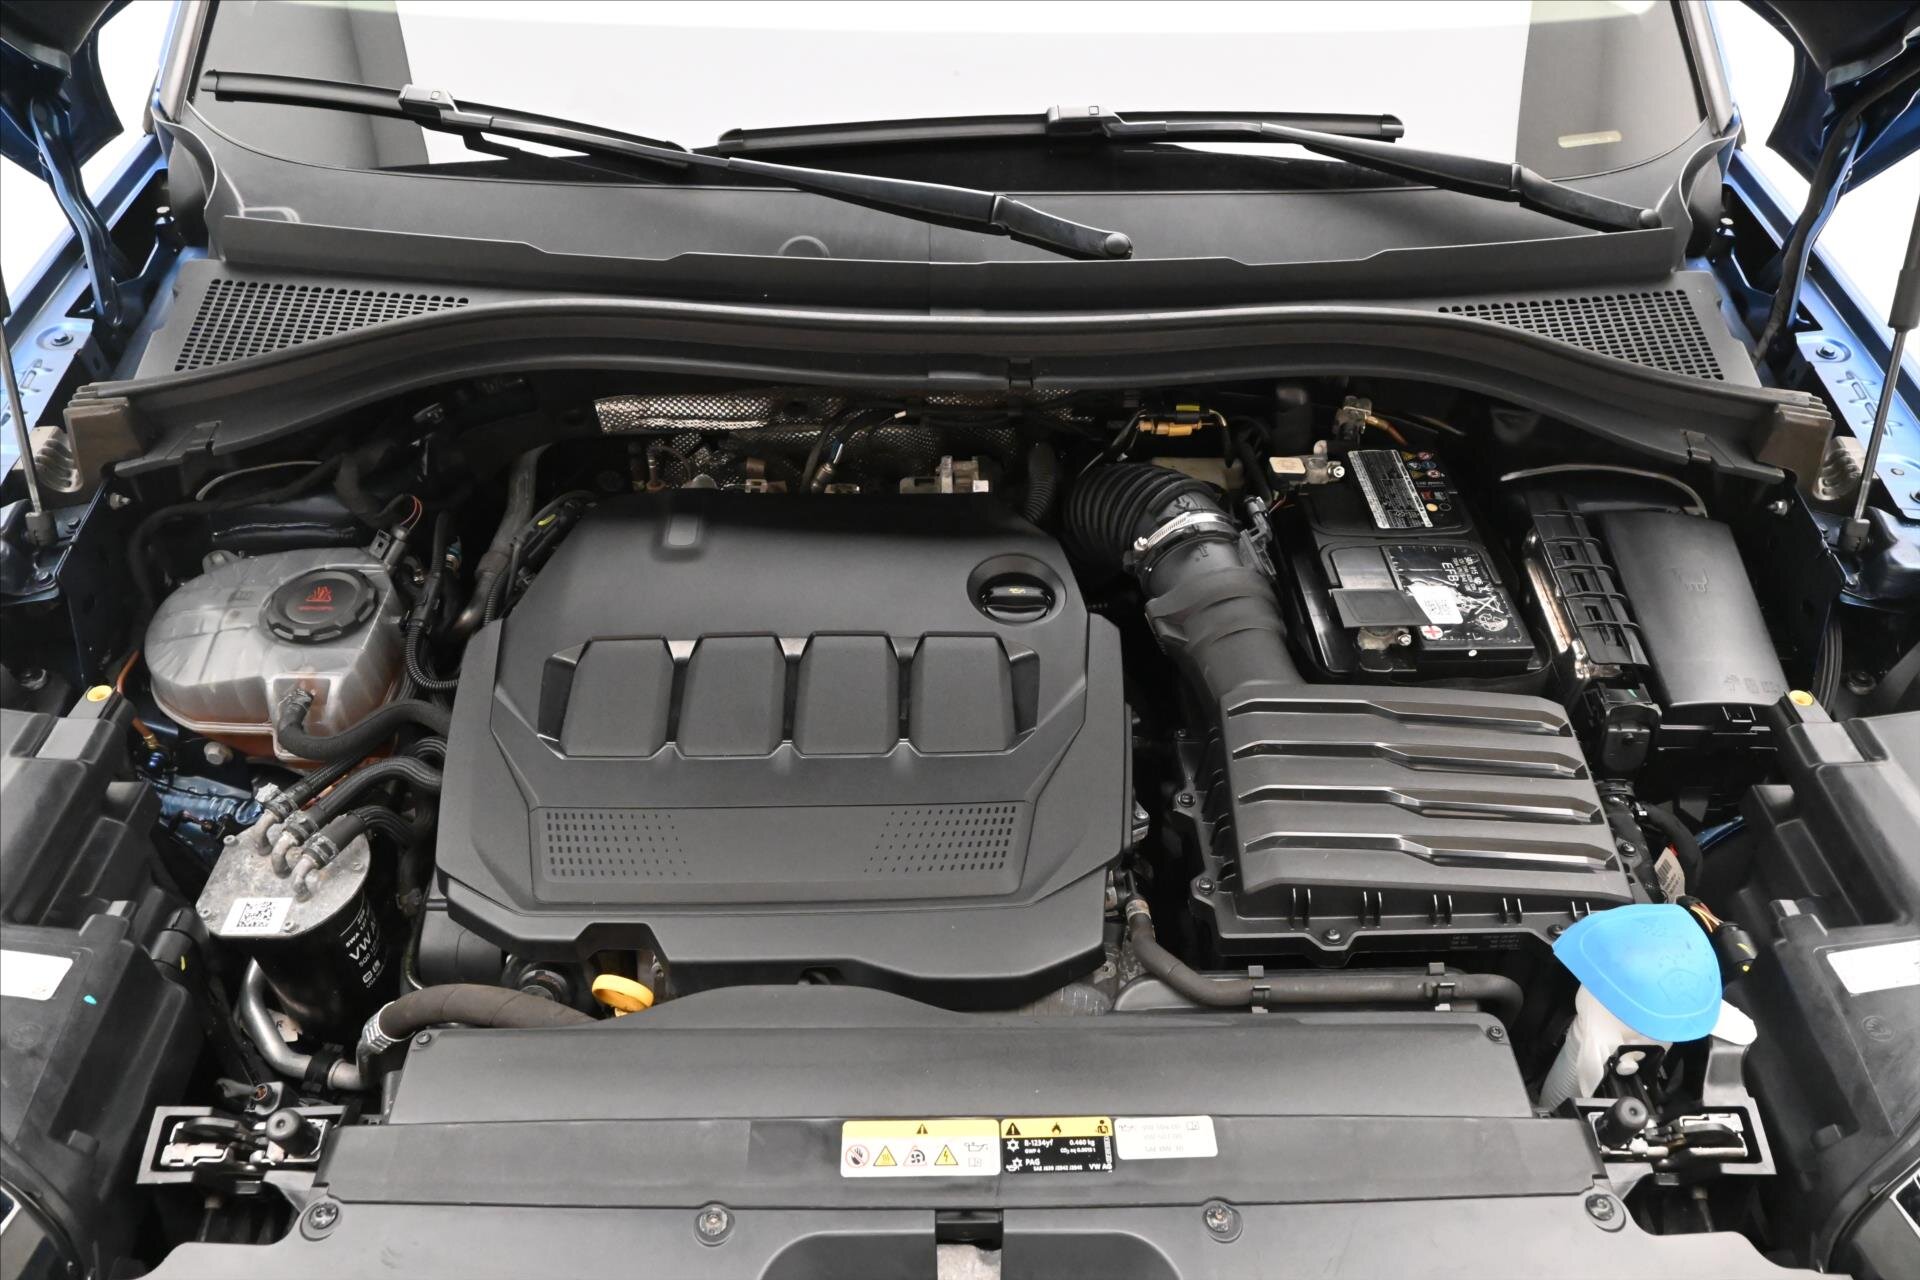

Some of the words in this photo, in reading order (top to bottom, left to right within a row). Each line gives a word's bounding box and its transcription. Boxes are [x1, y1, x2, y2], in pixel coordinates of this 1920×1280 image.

[349, 931, 371, 960] VW
[1087, 1139, 1095, 1147] kg
[1025, 1158, 1040, 1166] PAG
